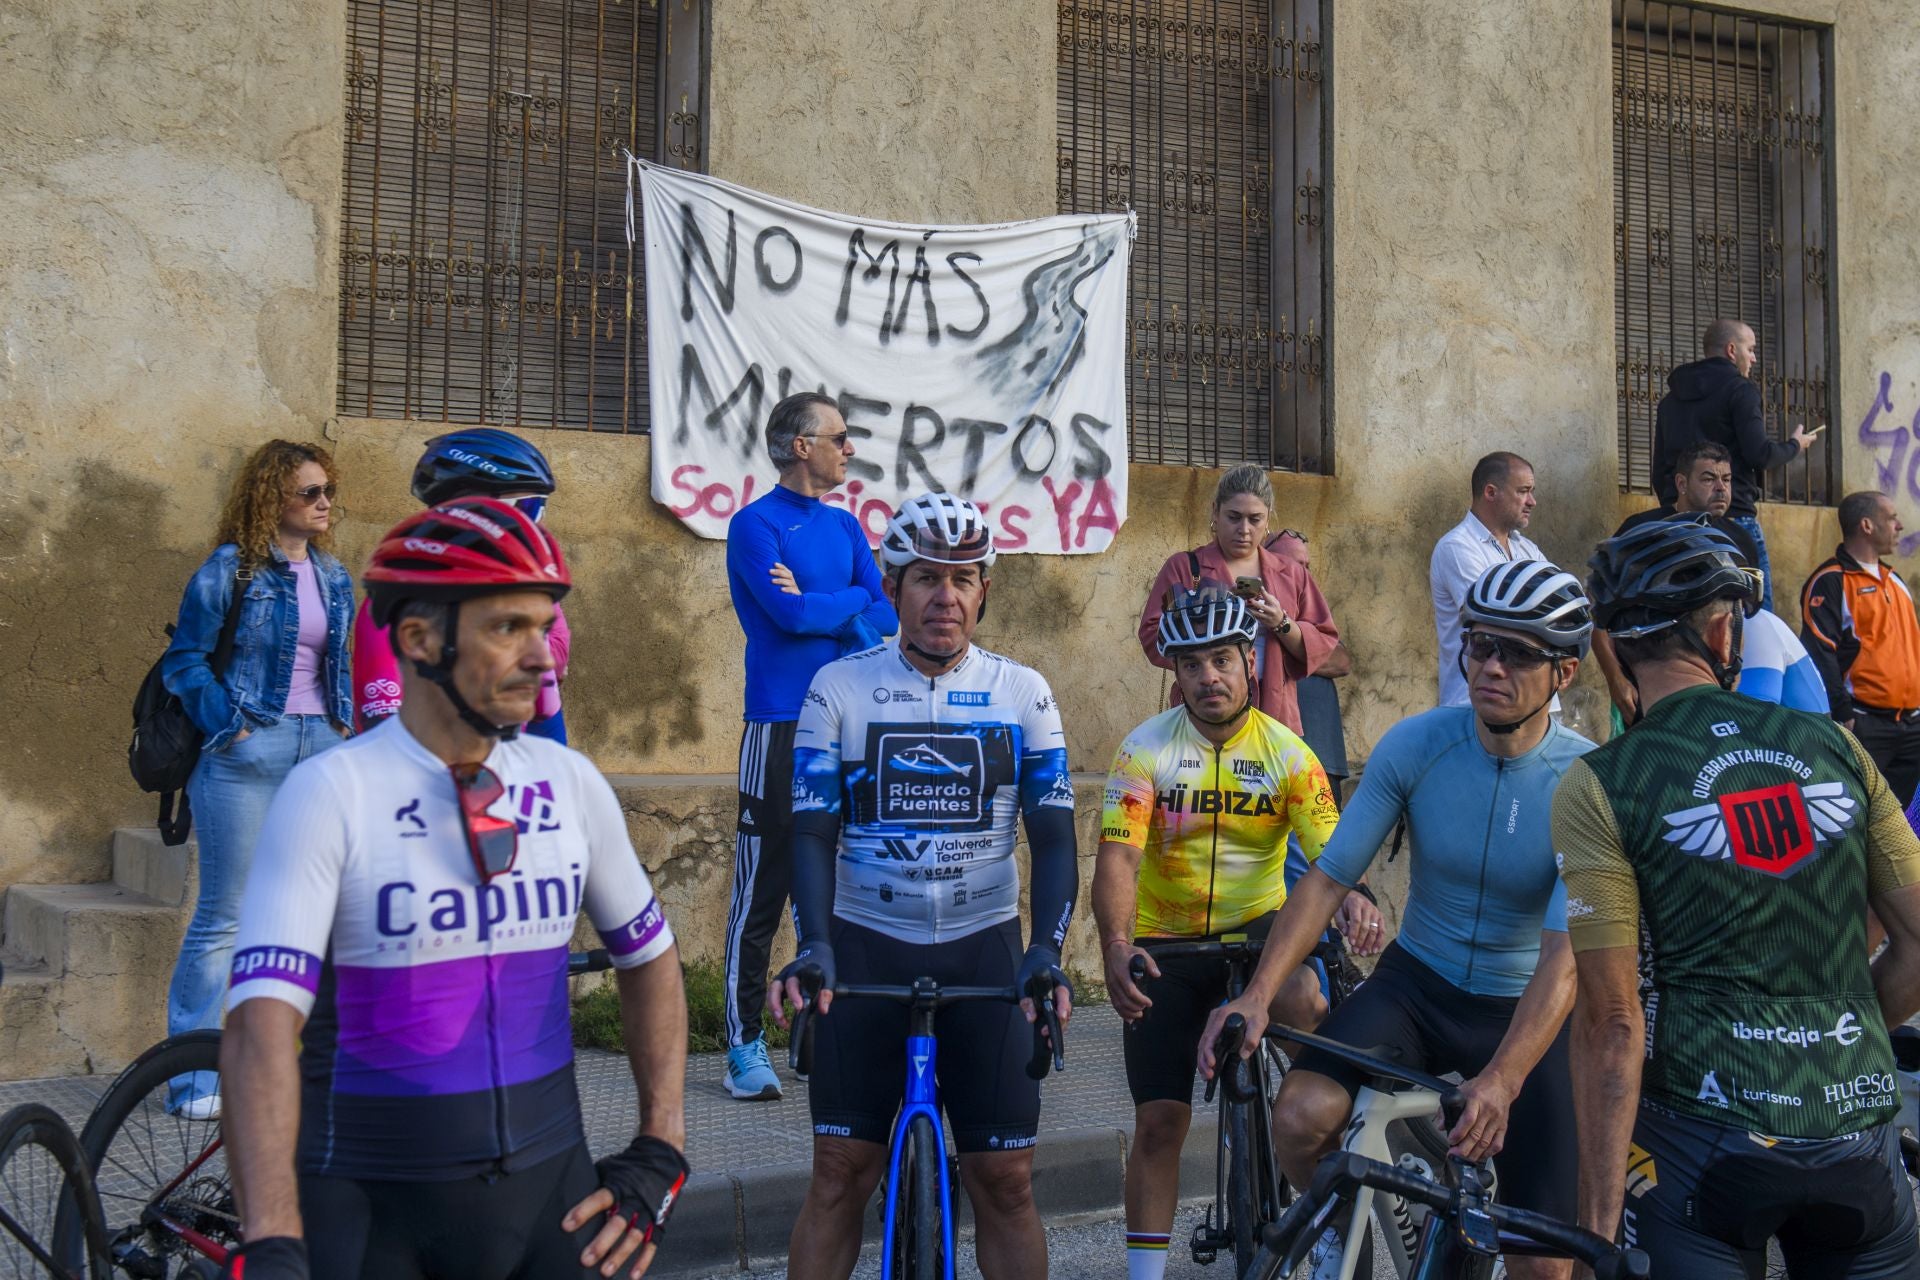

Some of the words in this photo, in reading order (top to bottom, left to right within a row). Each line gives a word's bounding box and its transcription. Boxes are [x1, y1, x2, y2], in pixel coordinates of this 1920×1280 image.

[679, 202, 803, 322] NO
[835, 230, 991, 346] MÁS
[675, 343, 1112, 494] MERTOS
[1041, 475, 1120, 551] YA
[951, 692, 984, 704] GOBIK
[1692, 749, 1813, 800] QUEBRANTAHUESOS
[889, 782, 971, 797] Ricardo
[889, 797, 971, 812] Fuentes
[1507, 797, 1520, 834] GSPORT
[1732, 795, 1803, 862] QH
[934, 837, 993, 852] Valverde
[935, 851, 974, 864] Team
[924, 866, 964, 877] UCAM
[377, 862, 581, 943] Capini
[1742, 1087, 1803, 1107] turismo
